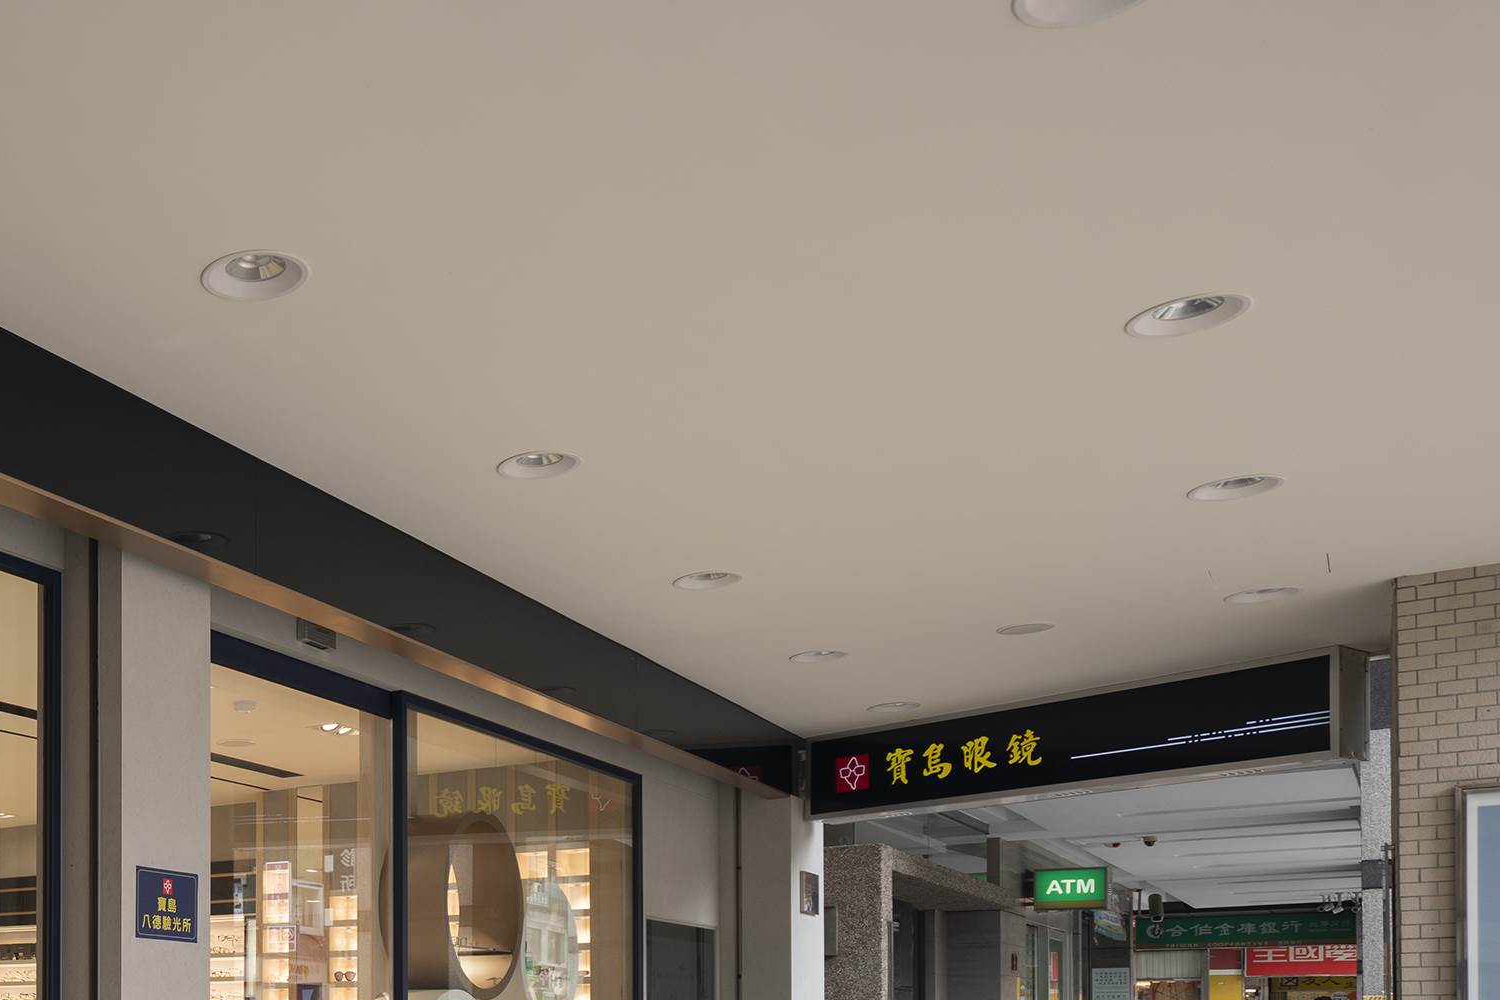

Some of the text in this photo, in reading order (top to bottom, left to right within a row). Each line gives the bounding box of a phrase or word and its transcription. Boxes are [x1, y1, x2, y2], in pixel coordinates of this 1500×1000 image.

[885, 728, 1043, 785] 寶島眼鏡
[1045, 877, 1096, 895] ATM
[156, 896, 177, 913] 寶島
[142, 913, 192, 933] 八德驗光所
[1165, 920, 1303, 937] 合作金庫銀行
